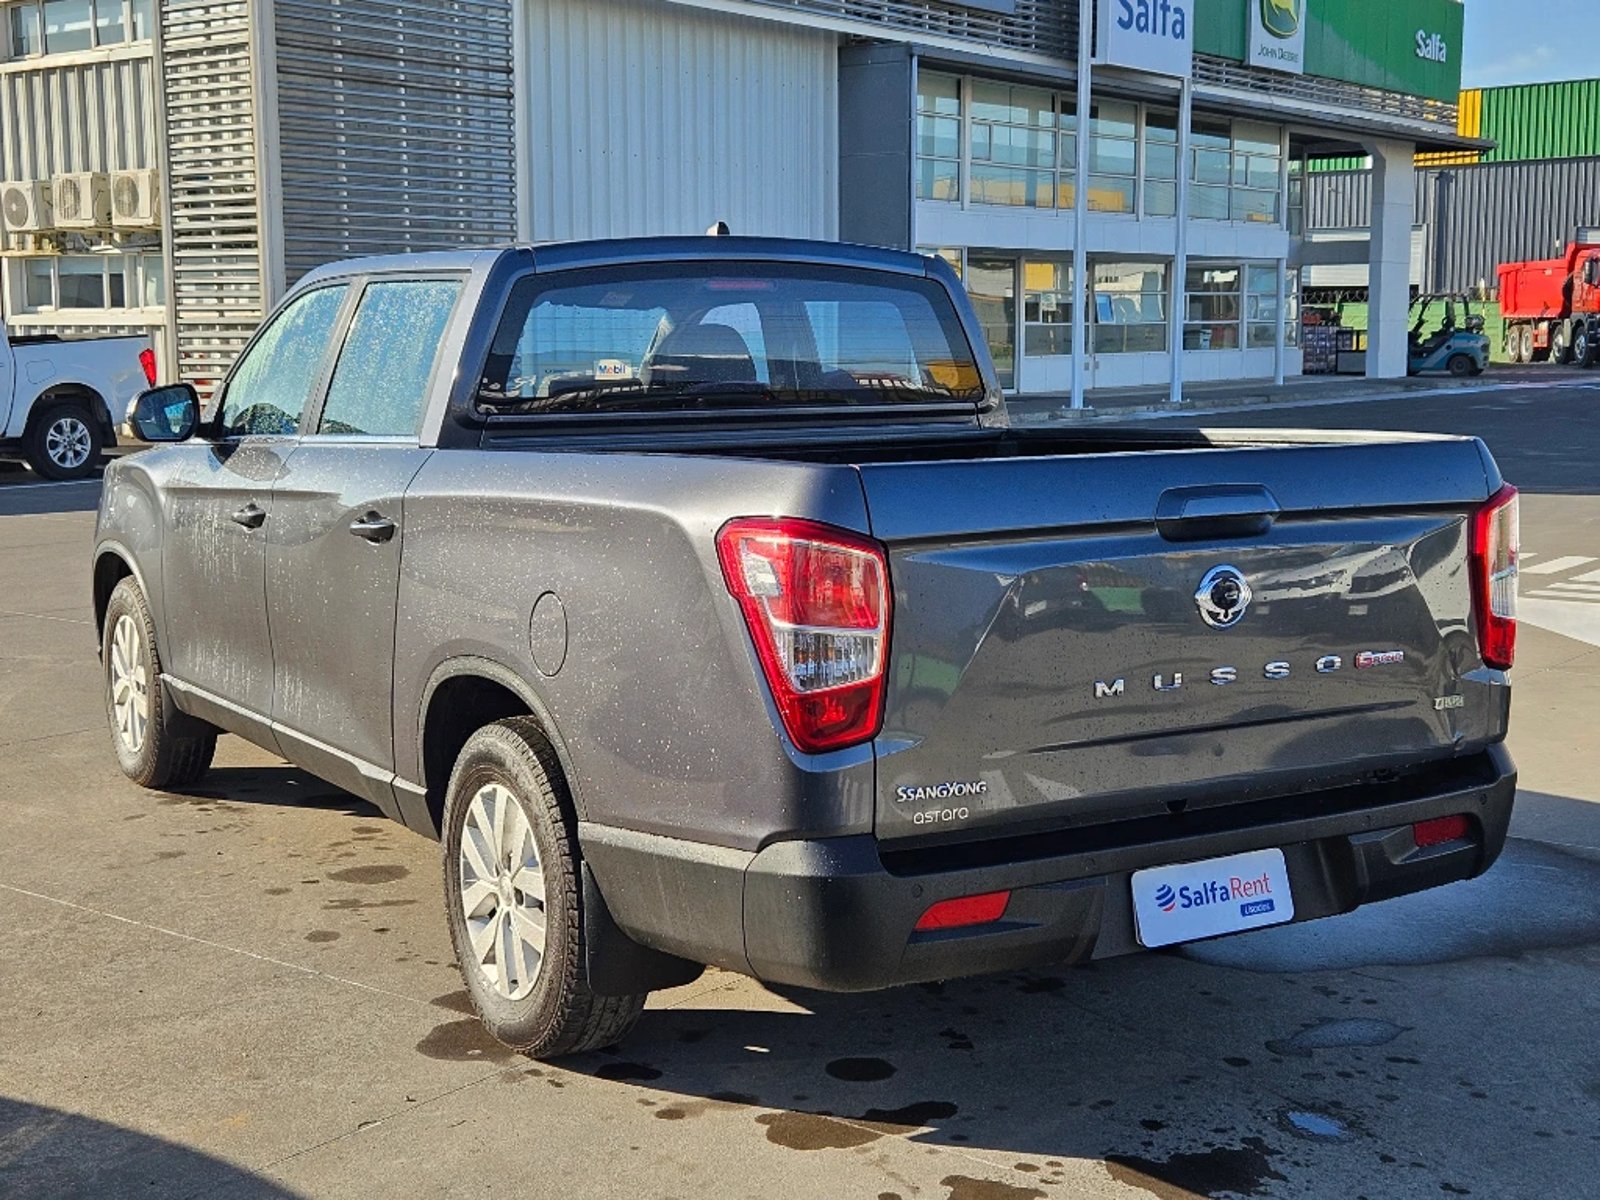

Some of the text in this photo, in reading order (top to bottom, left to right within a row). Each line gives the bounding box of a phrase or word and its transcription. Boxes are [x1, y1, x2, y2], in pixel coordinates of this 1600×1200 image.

[1117, 0, 1185, 40] Salfa
[1415, 29, 1446, 63] Salfa
[1094, 654, 1342, 698] MUSSO
